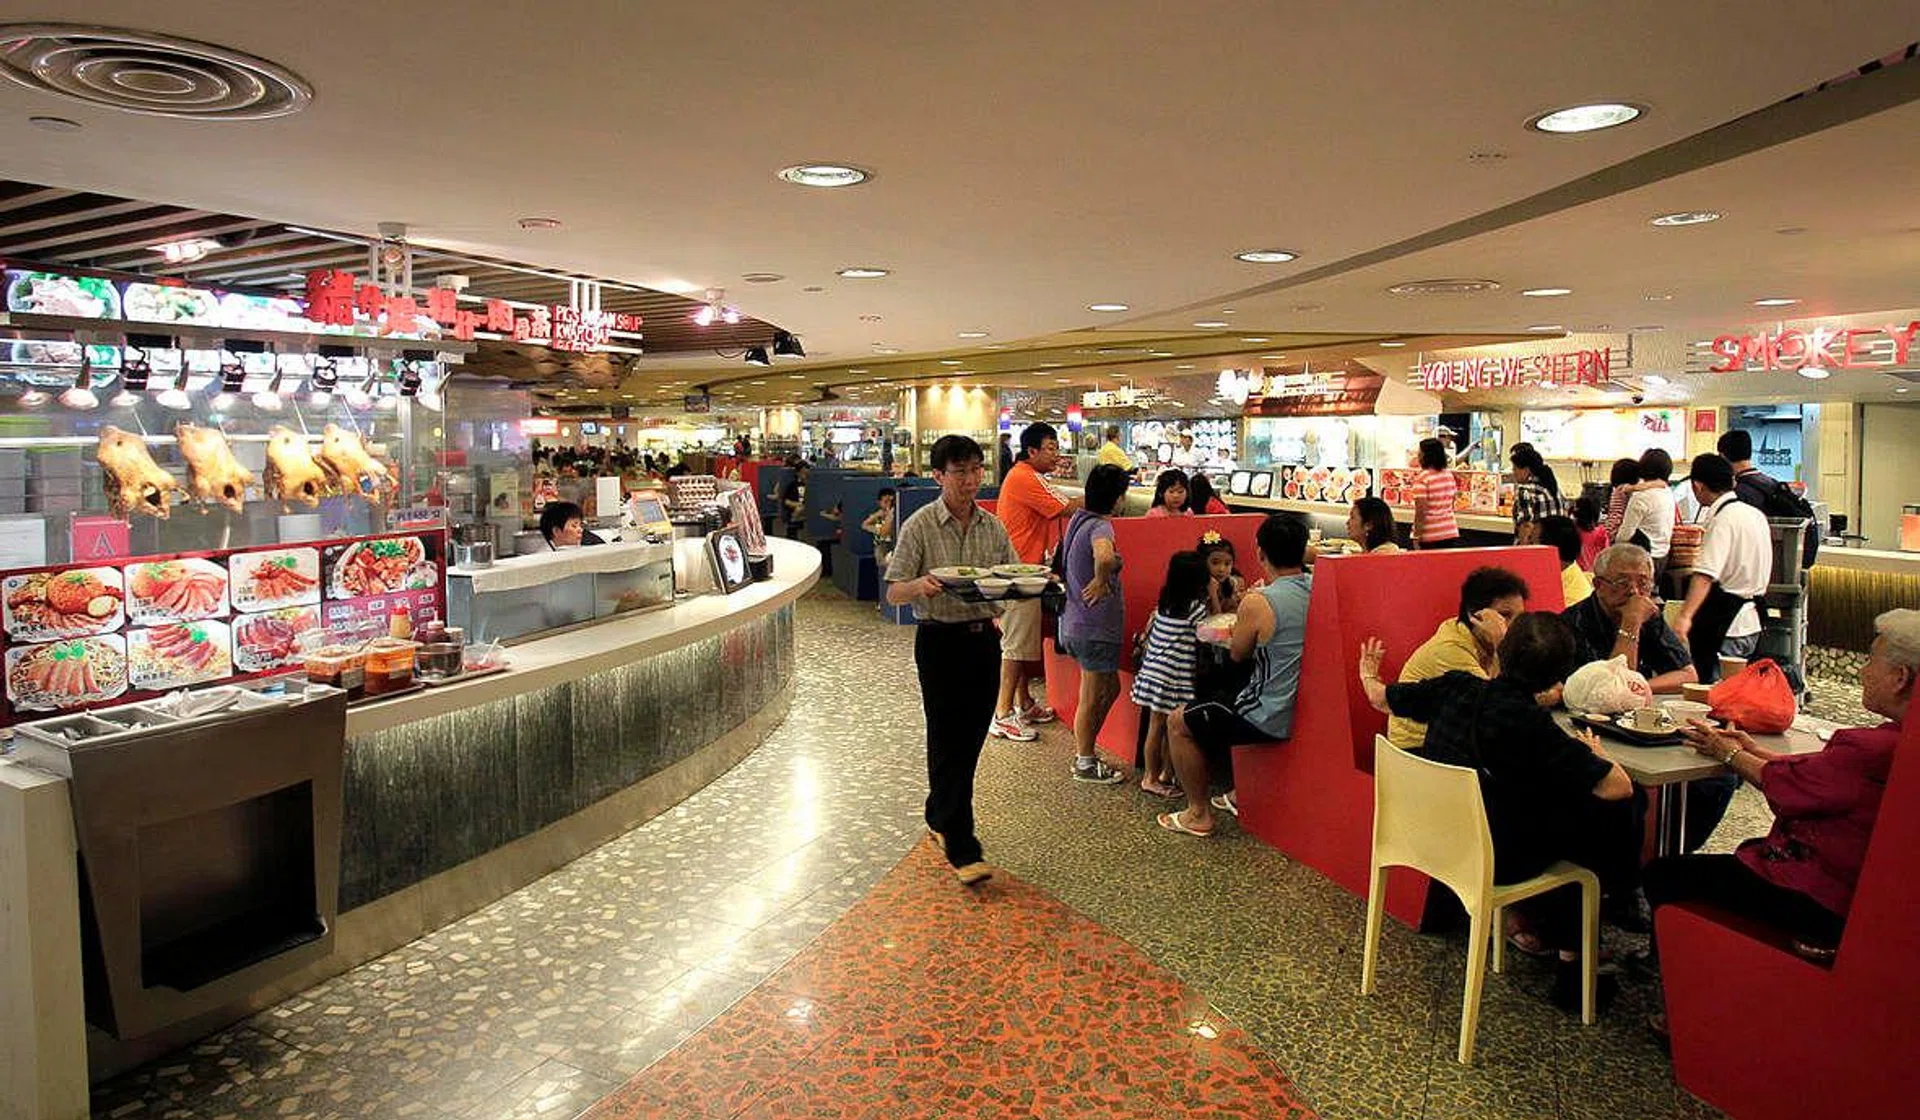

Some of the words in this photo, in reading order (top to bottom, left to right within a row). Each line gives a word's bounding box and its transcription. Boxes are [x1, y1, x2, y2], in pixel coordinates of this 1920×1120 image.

[616, 313, 643, 332] SOUP
[1709, 320, 1920, 373] SMOKEY
[1500, 347, 1611, 388] WESTERN
